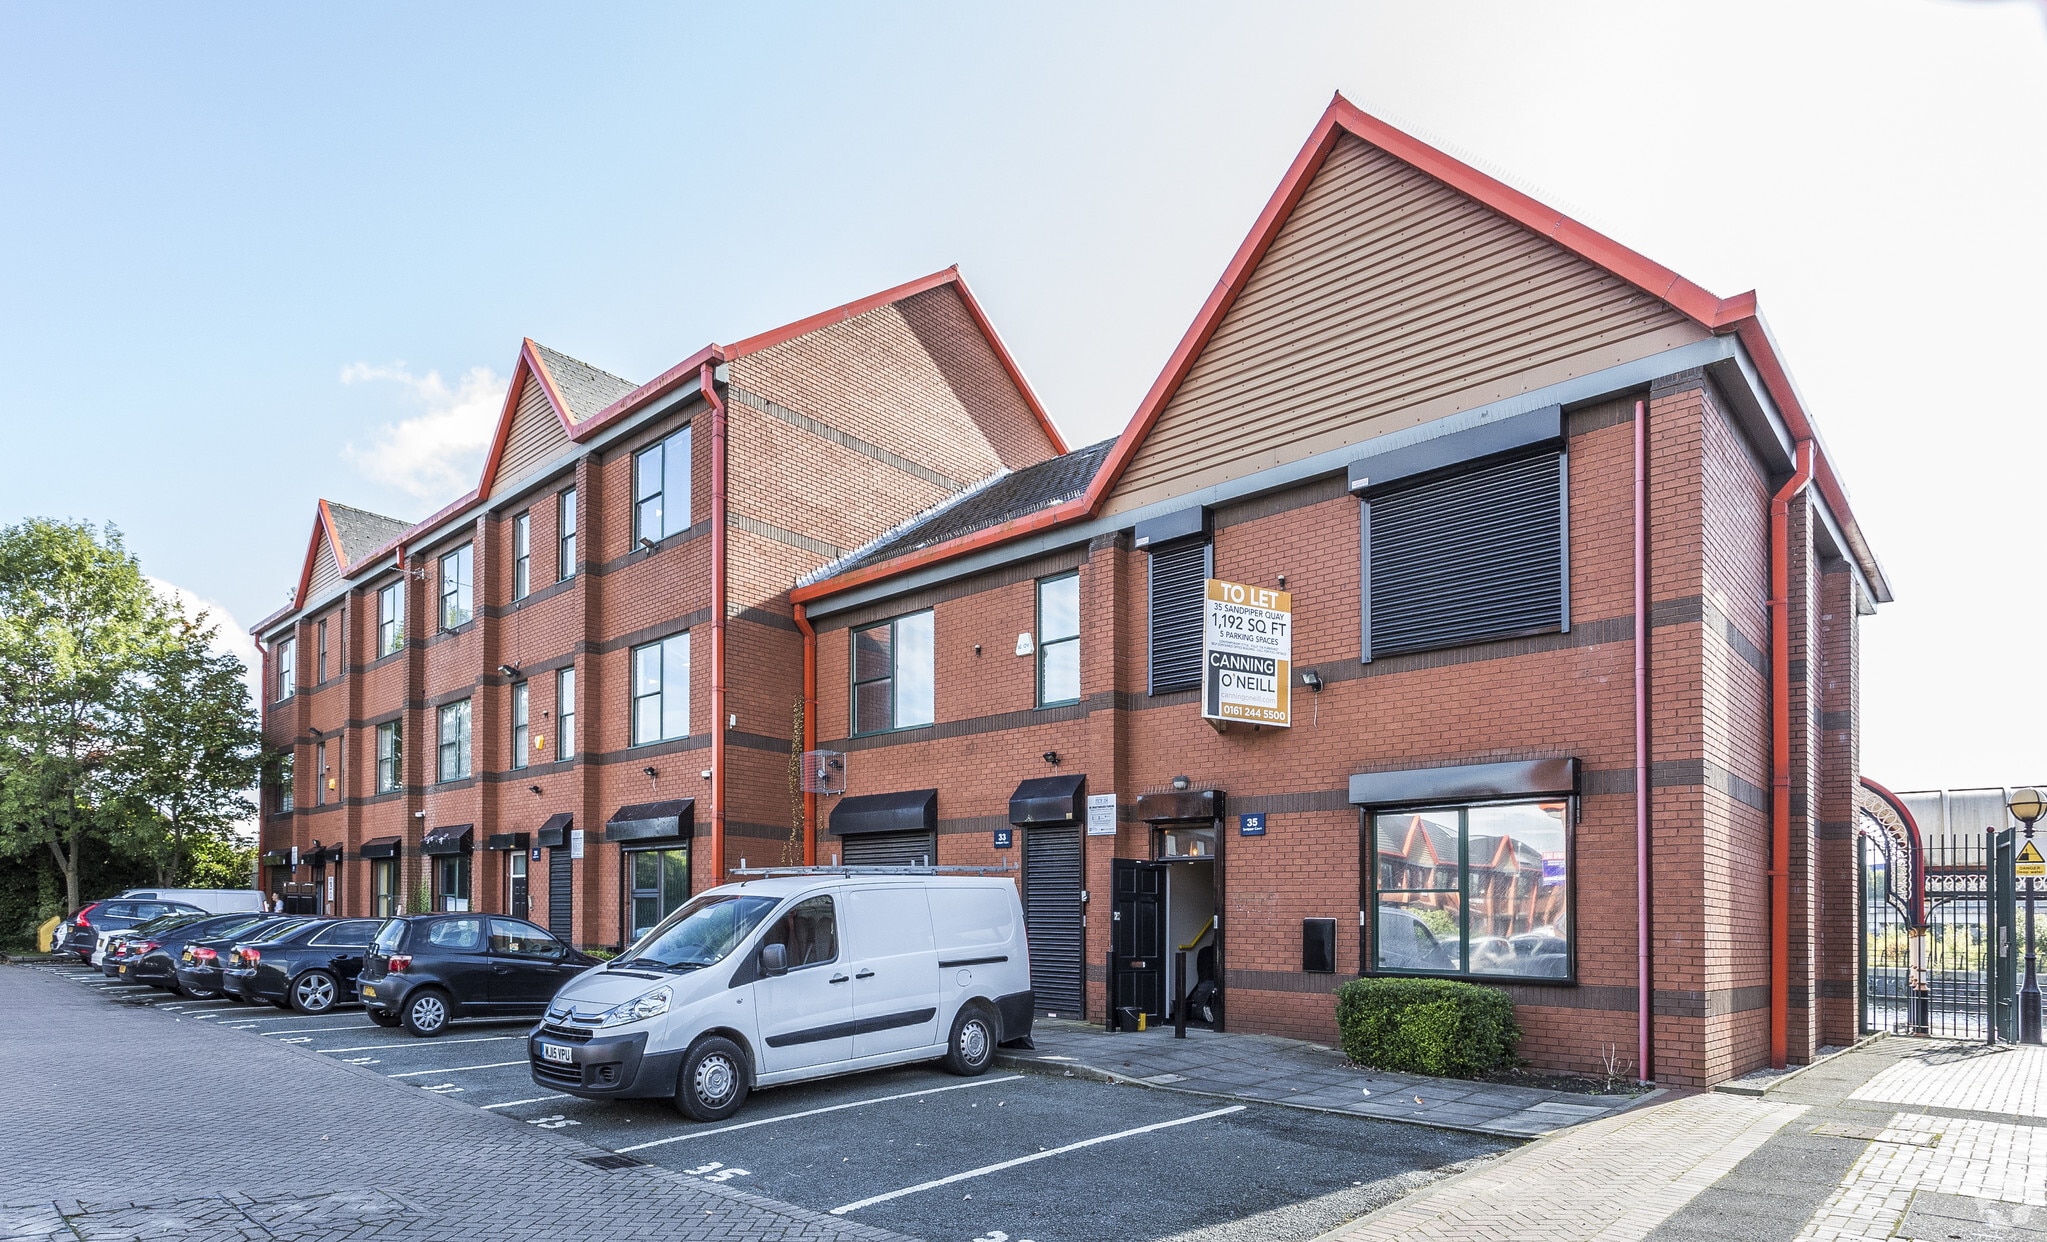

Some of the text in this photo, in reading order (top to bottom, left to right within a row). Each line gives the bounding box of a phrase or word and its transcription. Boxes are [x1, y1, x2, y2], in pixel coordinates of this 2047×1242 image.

[1220, 582, 1279, 609] TO LET
[1214, 602, 1285, 621] 35 SANDPIPER QUAY
[1211, 612, 1287, 637] 1,192 SQ FT
[1225, 631, 1254, 642] PARKING
[1255, 635, 1279, 646] SPACES
[1210, 652, 1274, 674] CANNING
[1221, 672, 1276, 693] O'NEILL
[1223, 705, 1286, 720] 0161 244 5500
[1246, 817, 1258, 827] 35
[998, 833, 1006, 841] 33
[682, 1161, 752, 1182] 35
